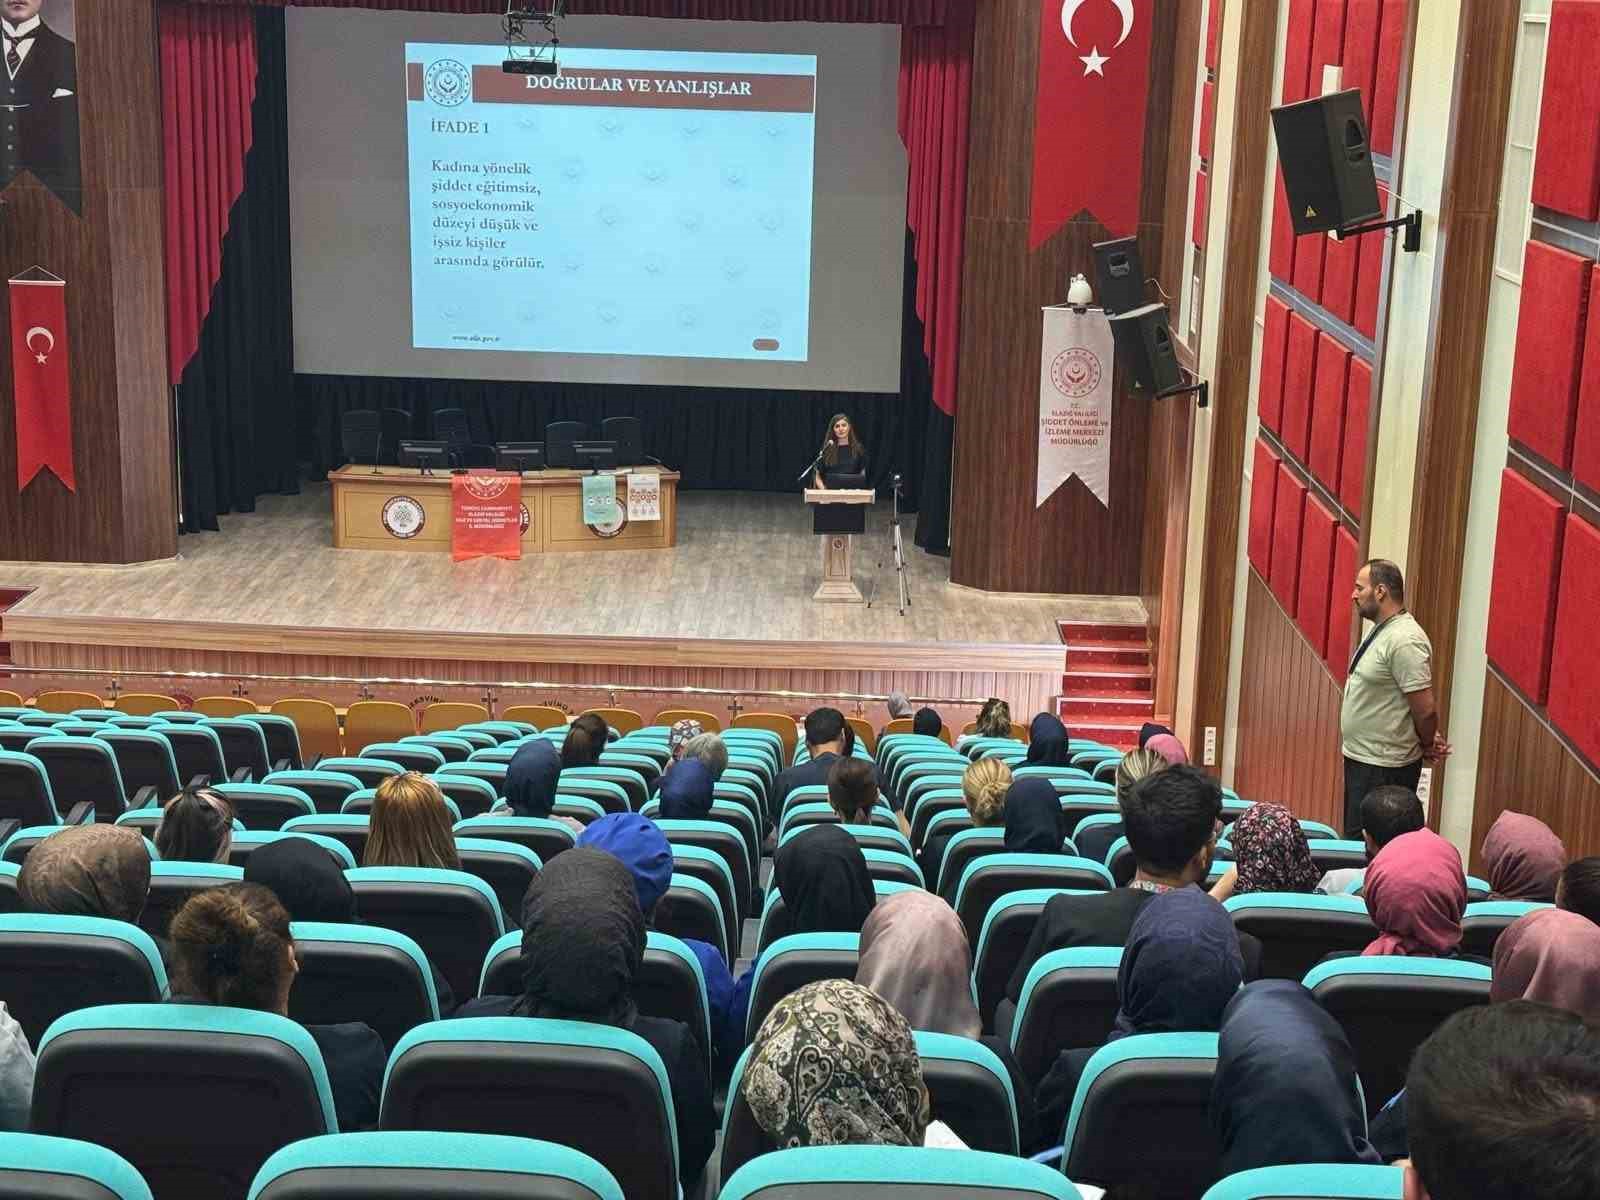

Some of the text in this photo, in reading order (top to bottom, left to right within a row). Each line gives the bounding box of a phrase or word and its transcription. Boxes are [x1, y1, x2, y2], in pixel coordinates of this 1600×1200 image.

[525, 75, 752, 98] DOĞRULAR VE YANLIŞLAR
[431, 117, 480, 134] İFADE
[431, 159, 532, 177] Kadına yönelik
[431, 179, 542, 196] şiddet eğitimsiz,
[431, 199, 535, 214] sosyoekonomik
[432, 216, 539, 233] düzeyi düşük ve
[432, 235, 507, 251] işsiz kişiler
[433, 255, 545, 272] arasında görülür.
[1068, 418, 1099, 427] ÖNLEME
